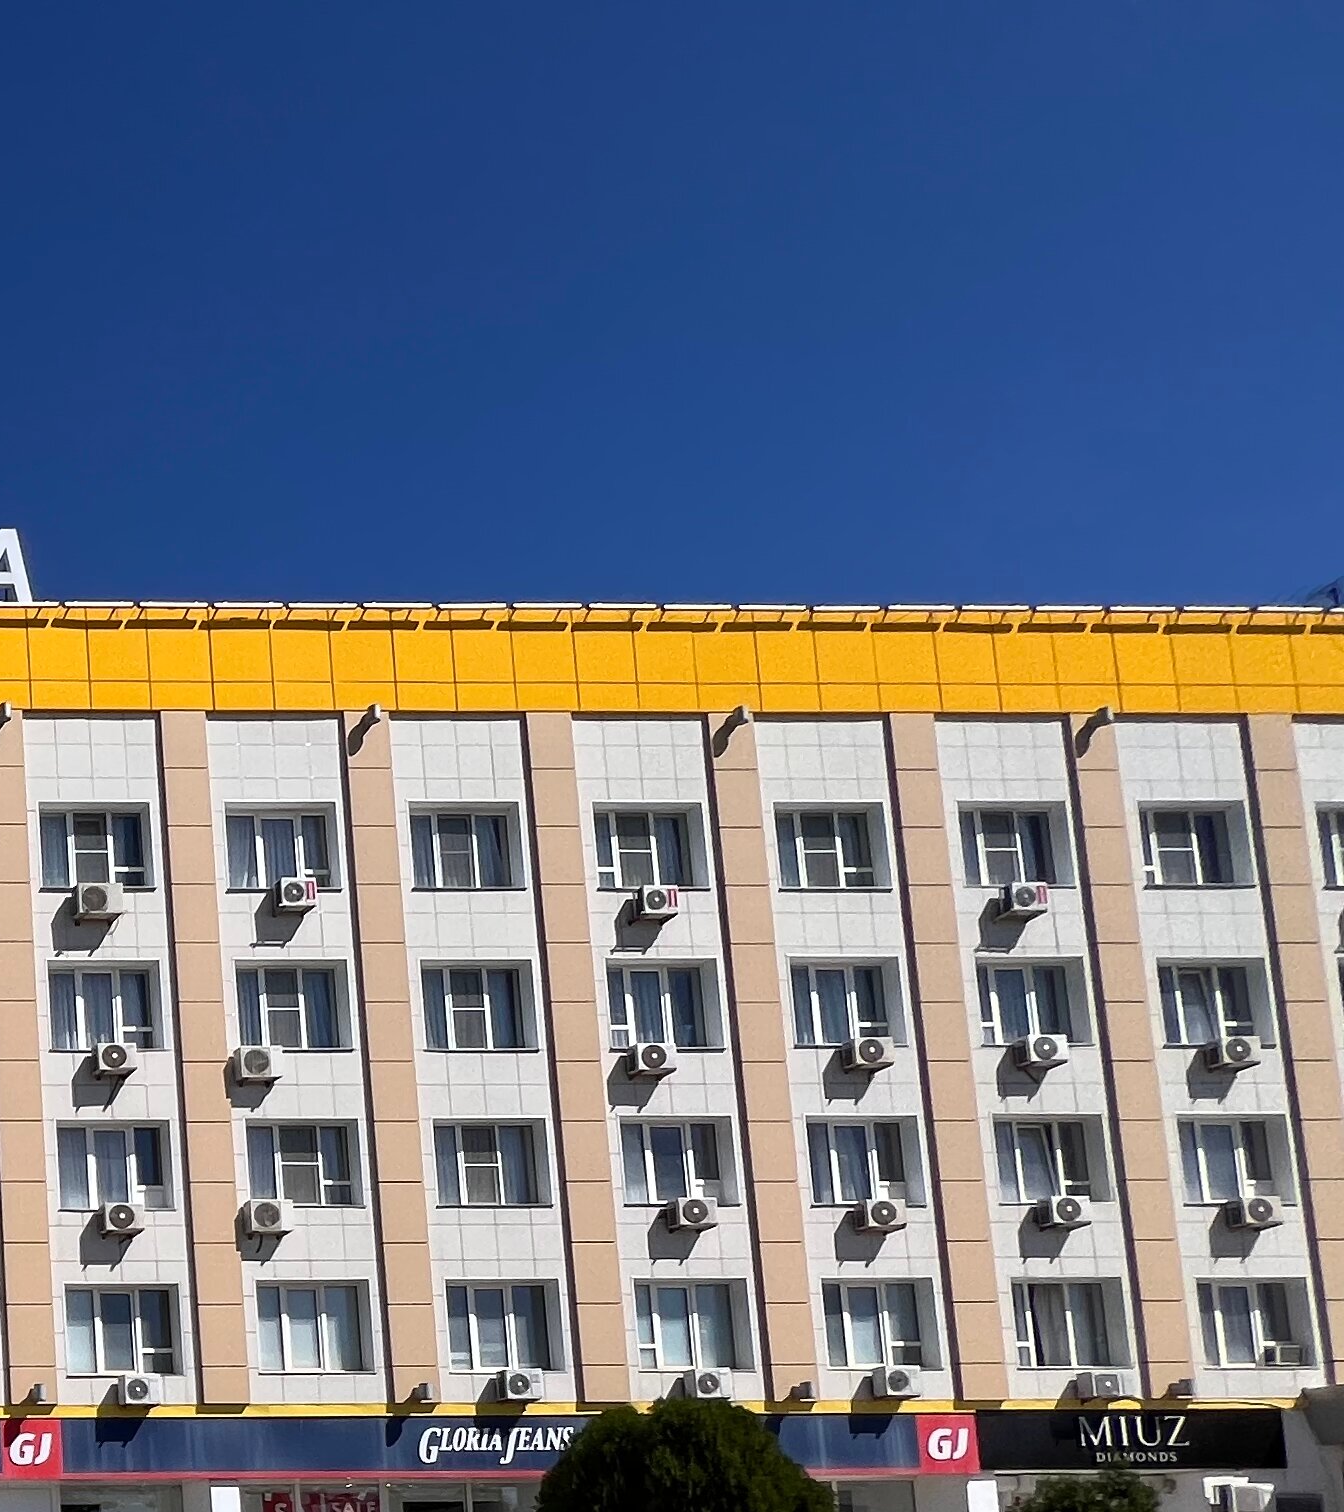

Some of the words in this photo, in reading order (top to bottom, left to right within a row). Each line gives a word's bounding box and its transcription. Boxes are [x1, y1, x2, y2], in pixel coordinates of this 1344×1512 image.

[418, 1427, 503, 1464] GLORIA
[499, 1427, 574, 1465] JEANS
[927, 1427, 969, 1461] GJ
[1078, 1415, 1190, 1447] MIUZ
[9, 1432, 53, 1466] GJ
